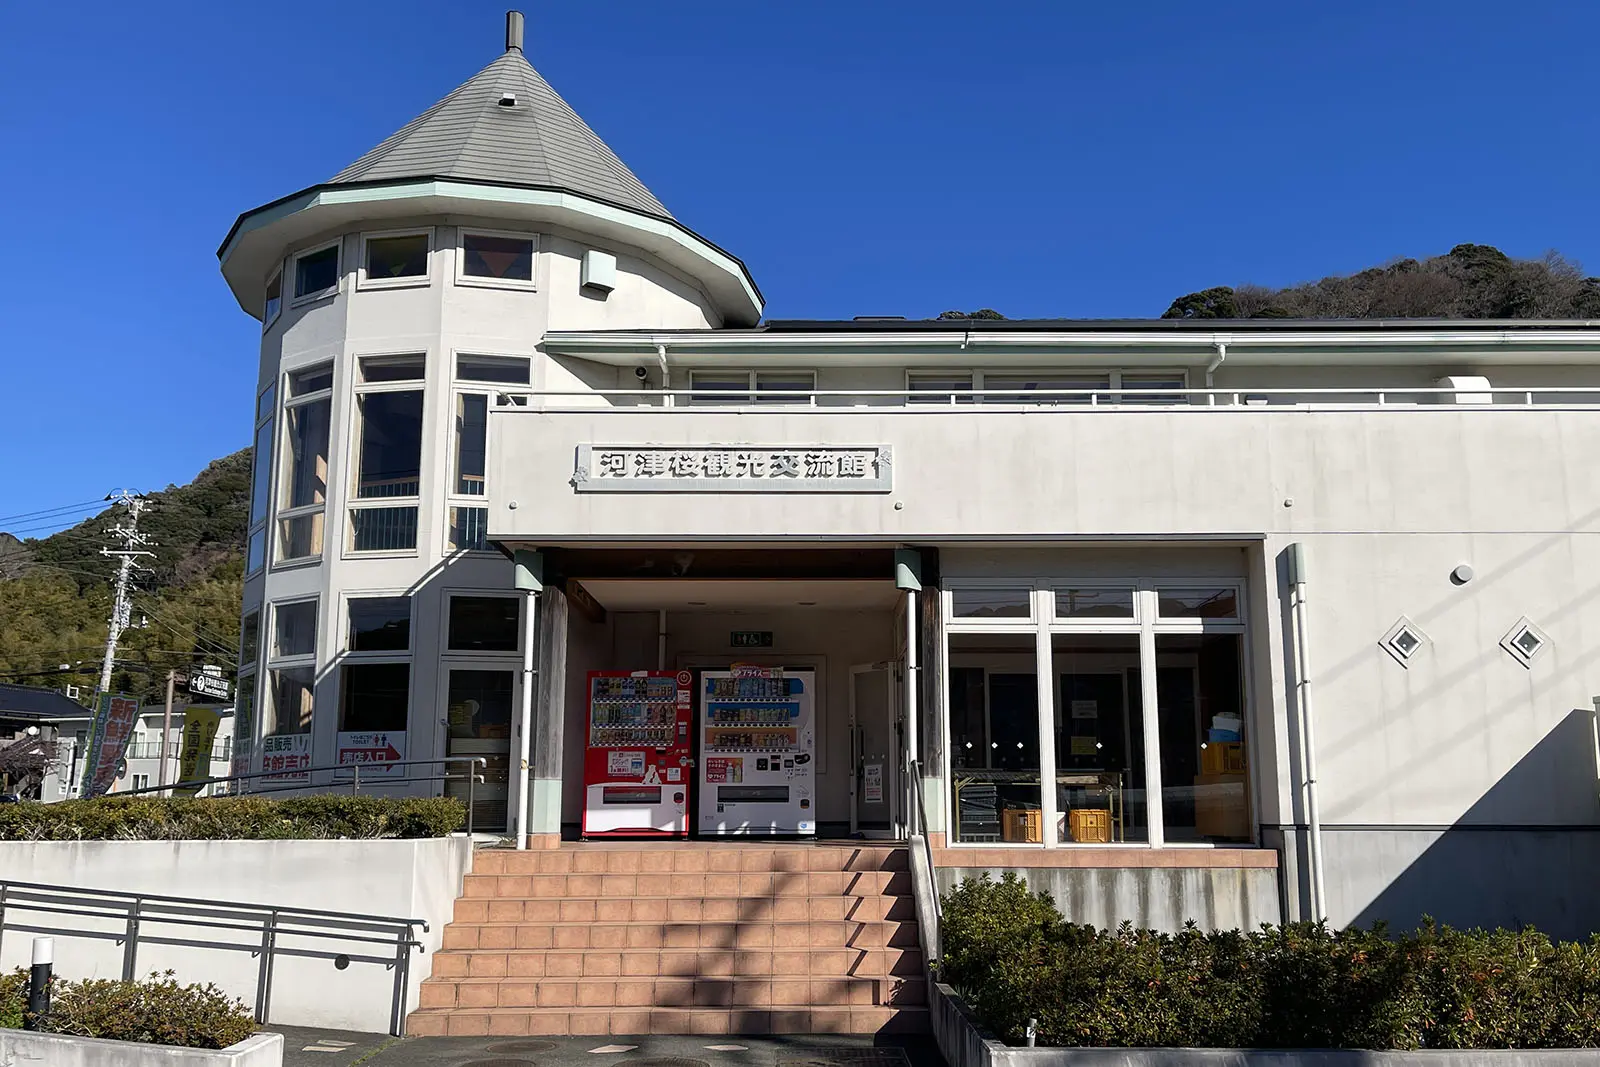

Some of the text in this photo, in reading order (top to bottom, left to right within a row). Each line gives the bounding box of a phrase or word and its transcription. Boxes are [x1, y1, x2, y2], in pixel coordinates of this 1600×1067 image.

[600, 450, 866, 478] 河津桜観光交流館
[343, 751, 387, 764] 売店入口
